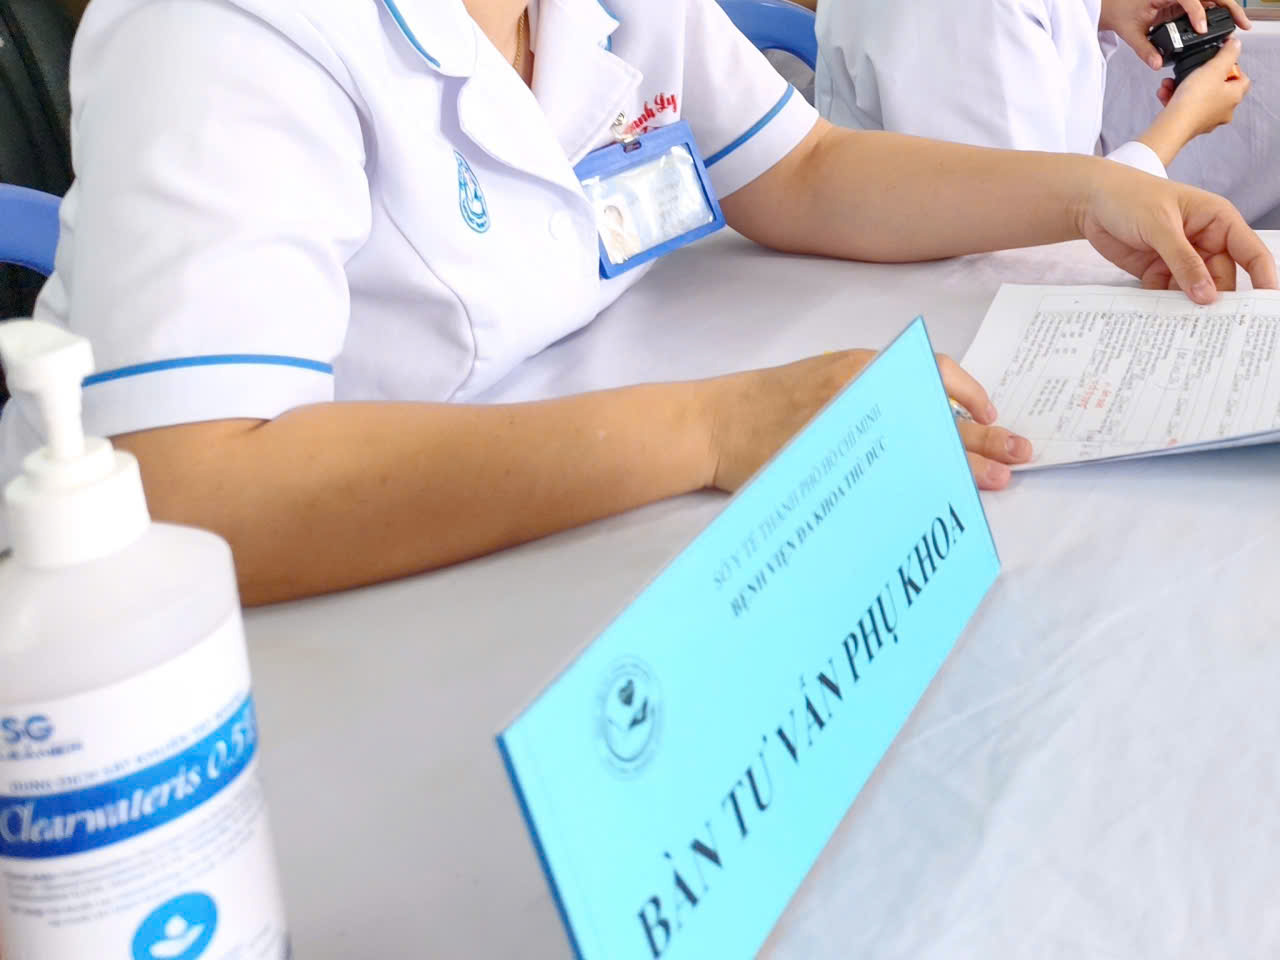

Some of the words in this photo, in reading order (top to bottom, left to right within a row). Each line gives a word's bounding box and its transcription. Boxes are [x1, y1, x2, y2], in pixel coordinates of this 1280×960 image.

[855, 403, 882, 435] MINH
[812, 487, 846, 527] KHOA
[636, 823, 724, 960] BÀN
[721, 734, 776, 839] TƯ
[776, 657, 846, 766] VẤN
[840, 582, 900, 684] PHỤ
[895, 501, 967, 609] KHOA
